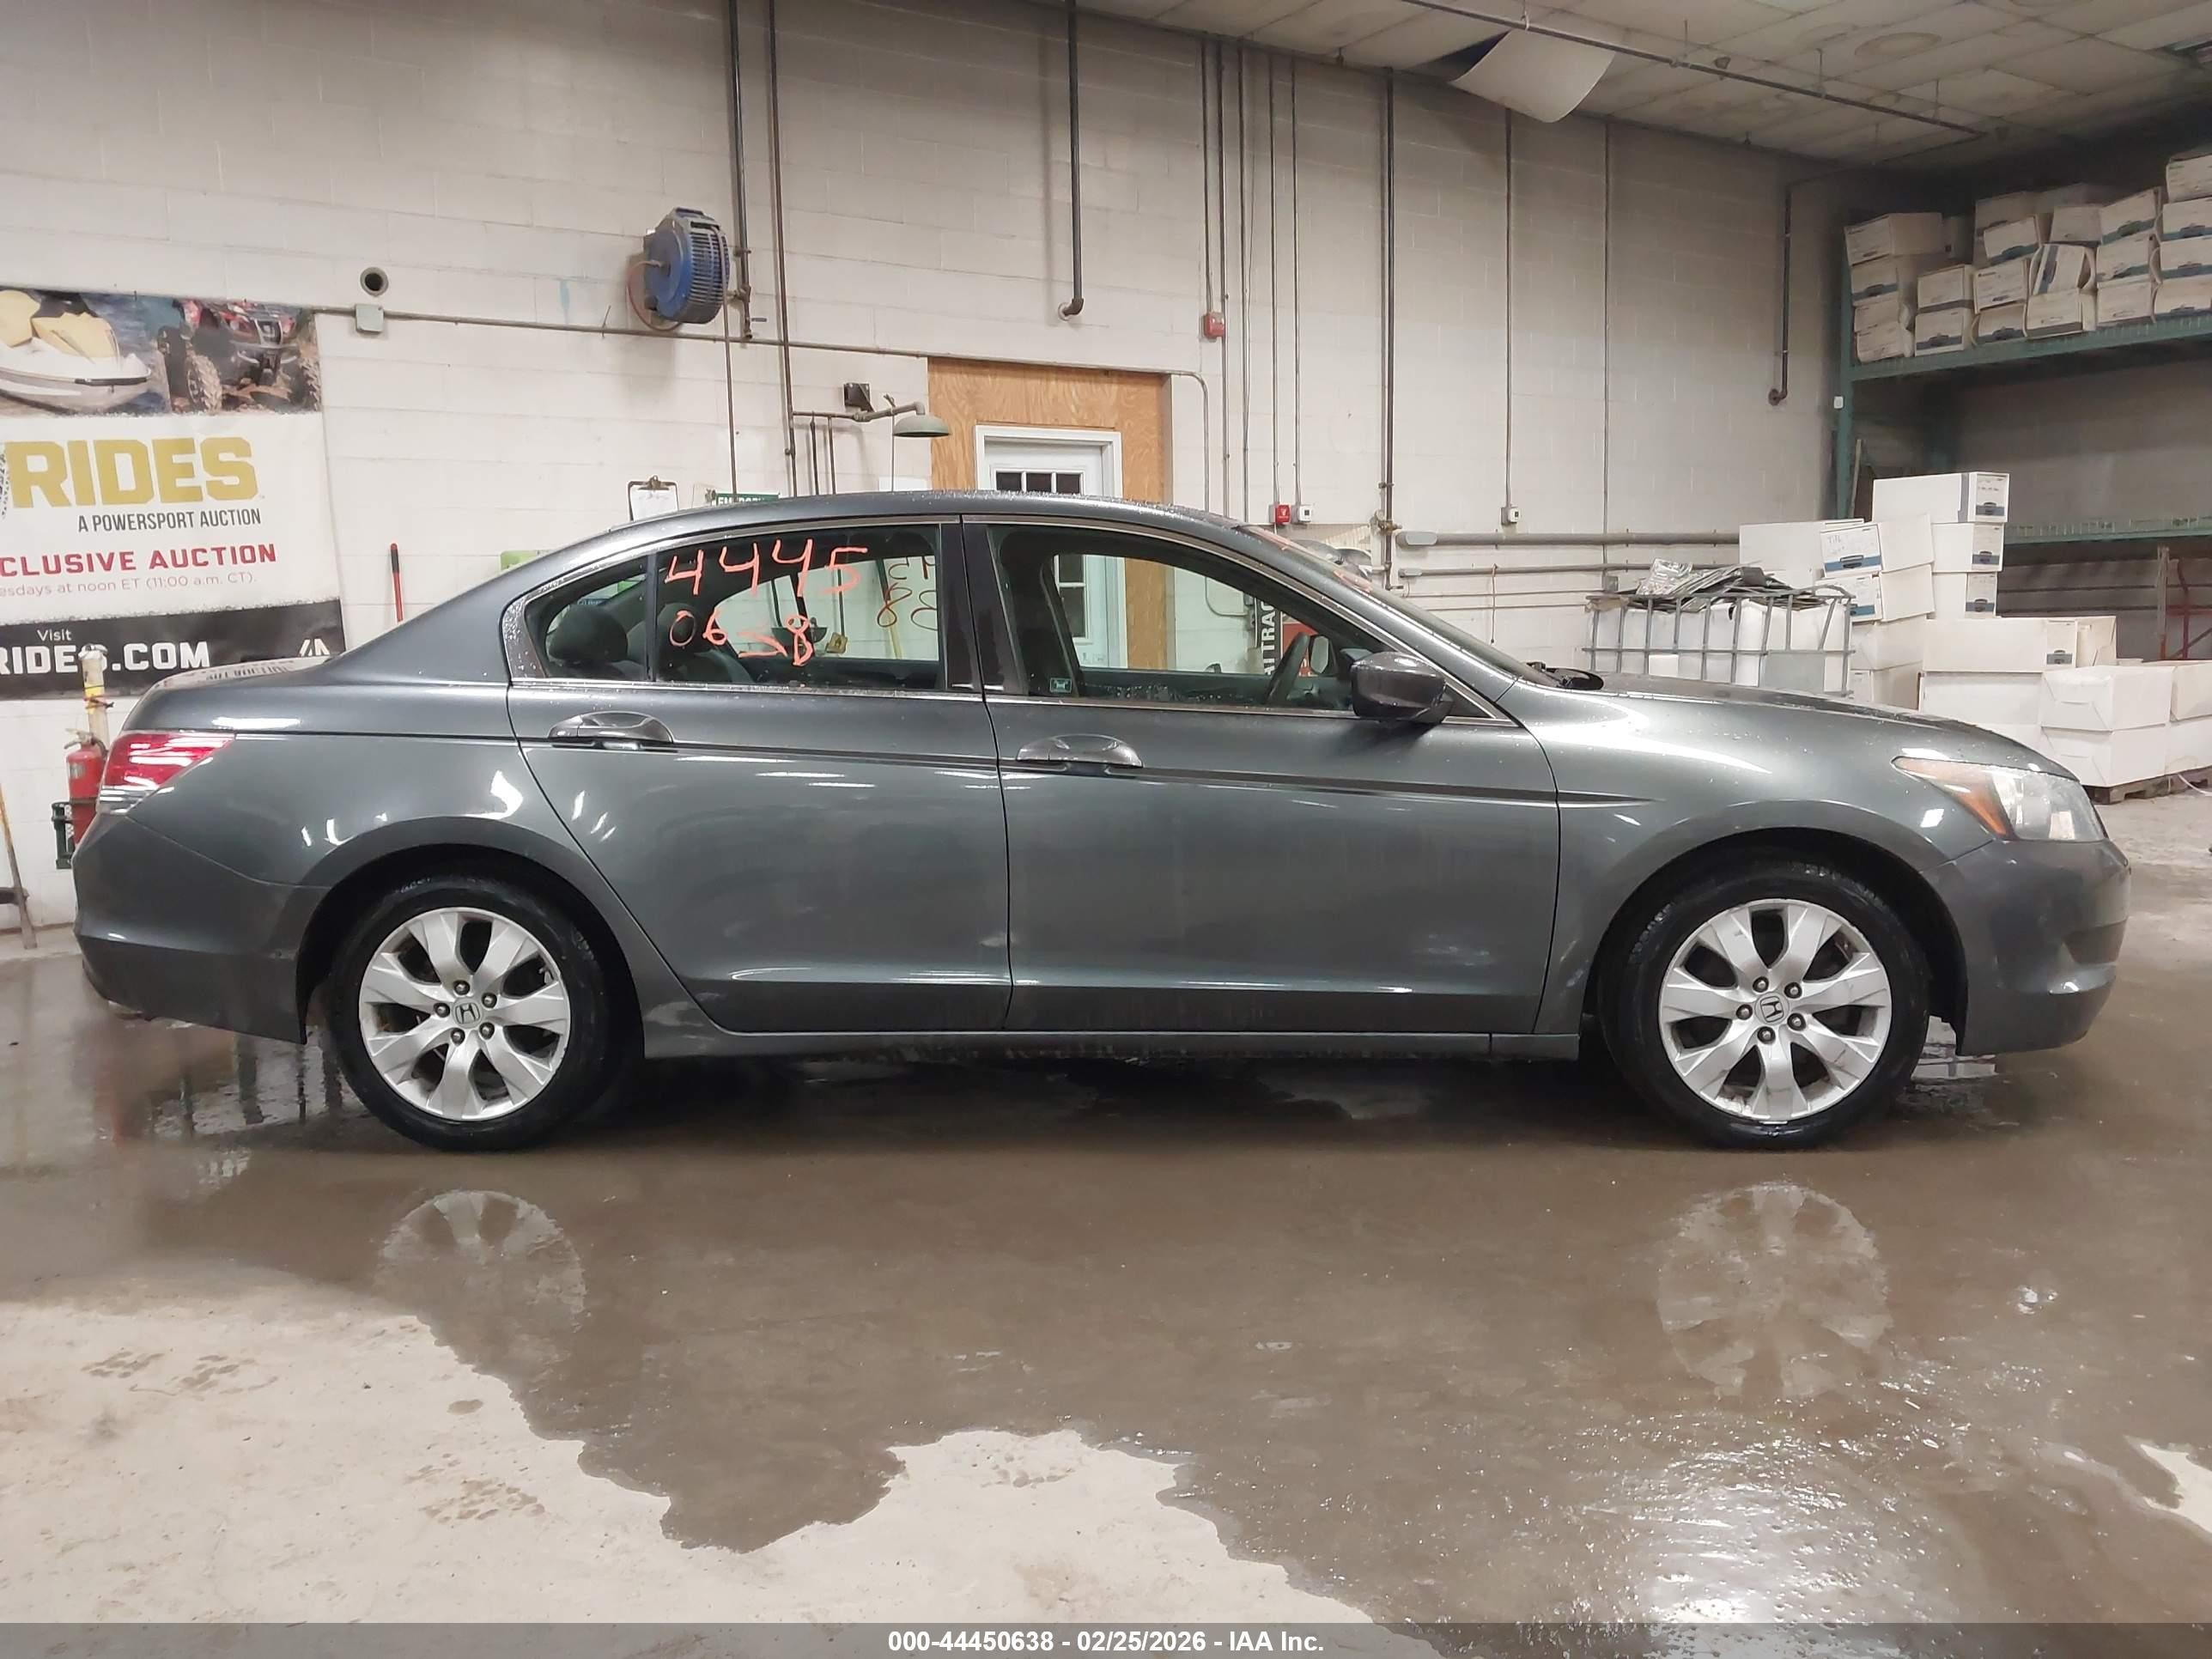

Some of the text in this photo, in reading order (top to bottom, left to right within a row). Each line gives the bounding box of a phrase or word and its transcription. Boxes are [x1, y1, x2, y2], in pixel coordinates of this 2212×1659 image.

[6, 436, 258, 508] RIDES
[78, 507, 262, 532] A POWERSPORT AUCTION
[149, 544, 277, 570] AUCTION
[665, 538, 868, 597] 4445
[58, 583, 72, 593] at
[78, 581, 116, 592] noon
[121, 578, 140, 591] ET
[146, 575, 188, 594] (11:00
[193, 576, 223, 590] a.m.
[37, 629, 72, 641] Visit
[0, 641, 210, 675] IDE.COM
